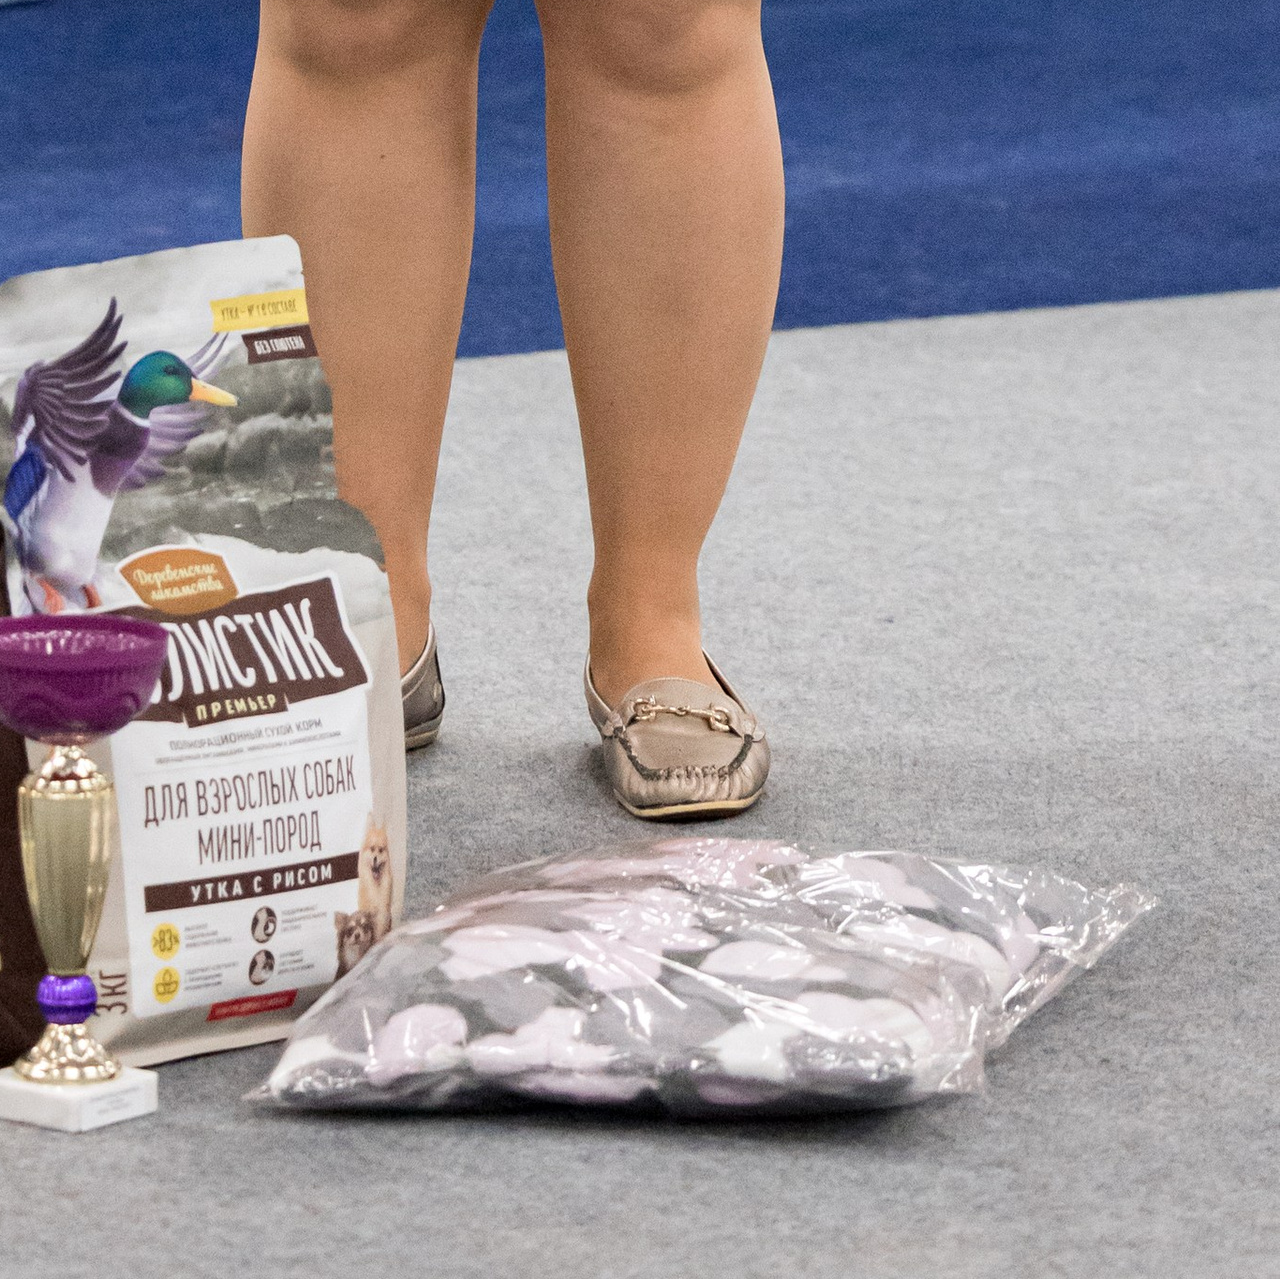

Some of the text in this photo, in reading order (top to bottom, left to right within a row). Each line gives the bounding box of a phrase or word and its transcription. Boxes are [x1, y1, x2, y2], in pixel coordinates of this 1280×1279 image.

[150, 598, 344, 704] ЛИСТИК
[195, 694, 277, 721] ПРЕМЬЕР
[296, 718, 323, 733] КОРМ
[144, 754, 356, 828] ДЛЯ ВЗРОСЛЫХ СОБАК
[198, 810, 322, 865] МИНИ-ПОРОД
[191, 863, 332, 902] УТКА С РИСОМ
